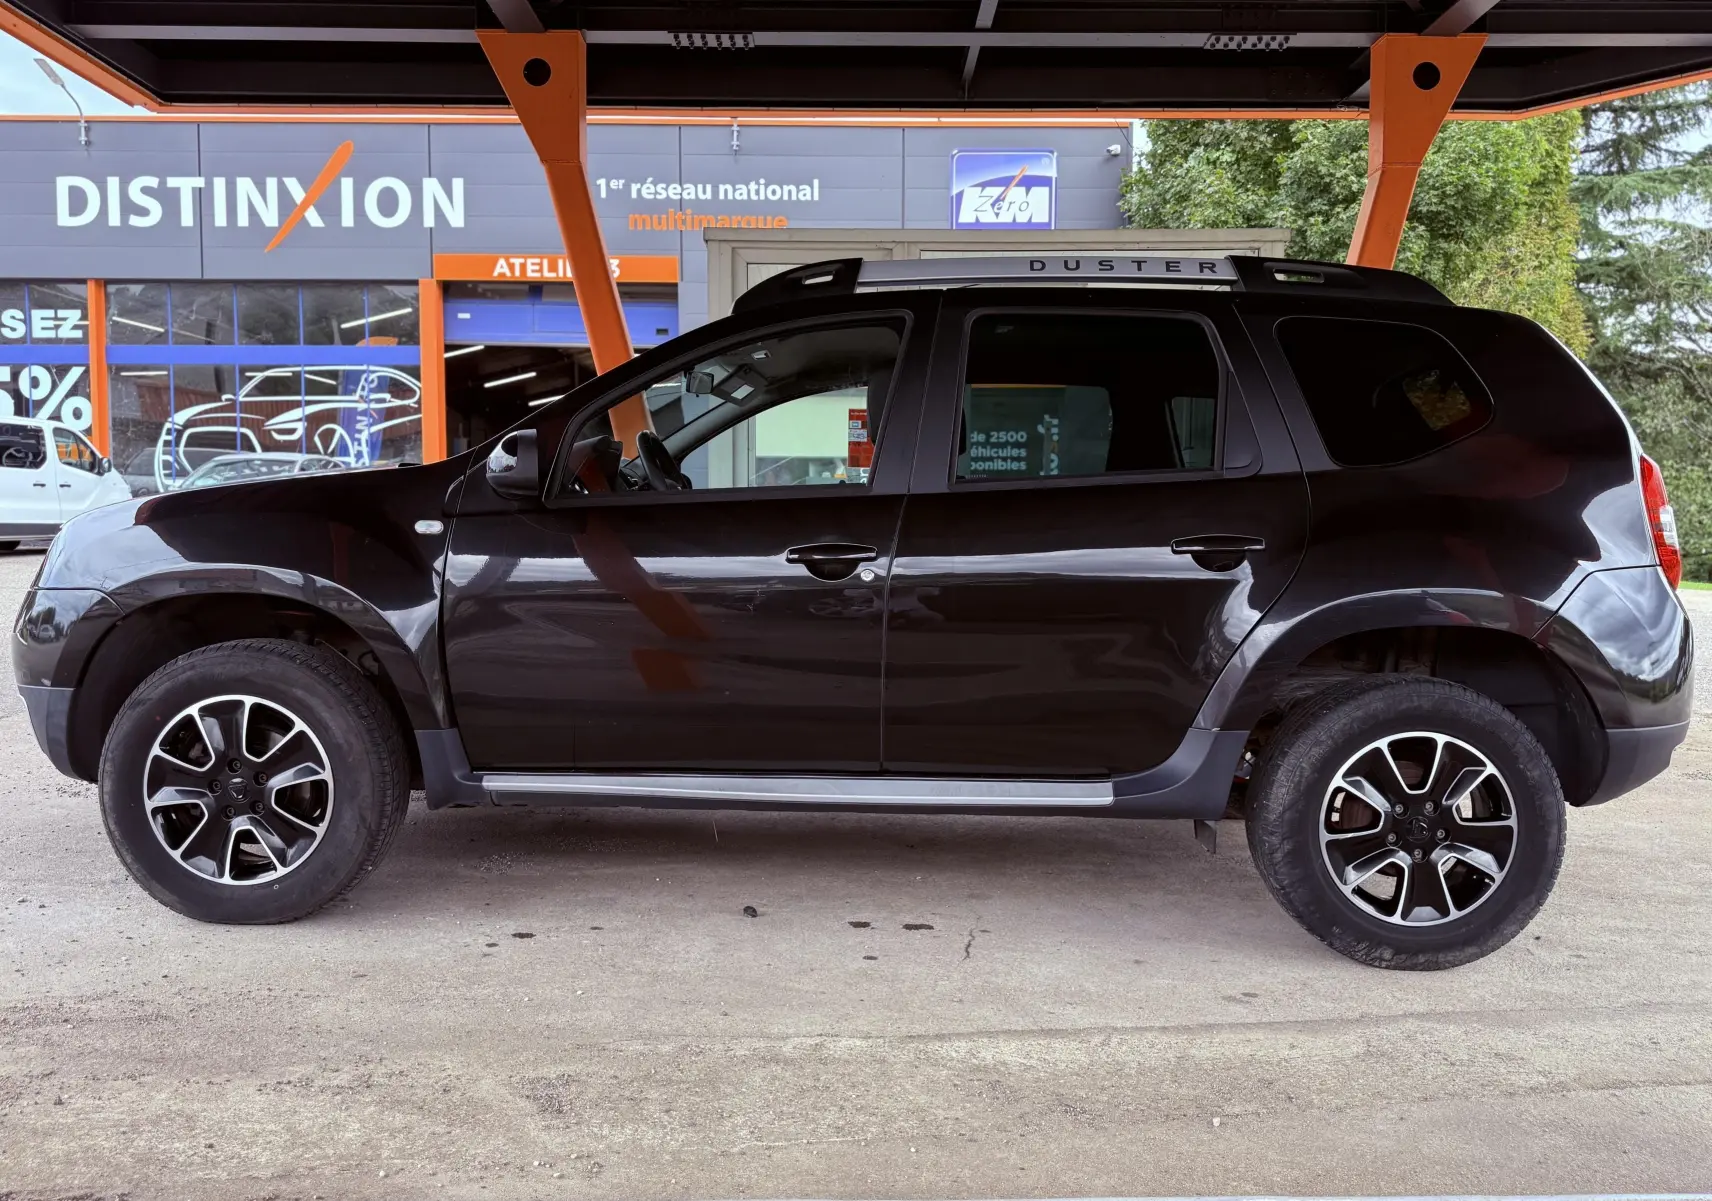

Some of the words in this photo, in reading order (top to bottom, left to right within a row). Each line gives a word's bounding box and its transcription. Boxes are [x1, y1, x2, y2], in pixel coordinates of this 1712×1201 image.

[56, 141, 465, 253] DISTINXION
[596, 178, 625, 199] 1er
[630, 177, 712, 200] réseau
[718, 178, 819, 201] national
[958, 186, 1050, 223] KM
[493, 257, 573, 278] ATELI
[1029, 259, 1217, 274] DUSTER
[0, 308, 83, 339] SEZ
[990, 431, 1028, 443] 2500
